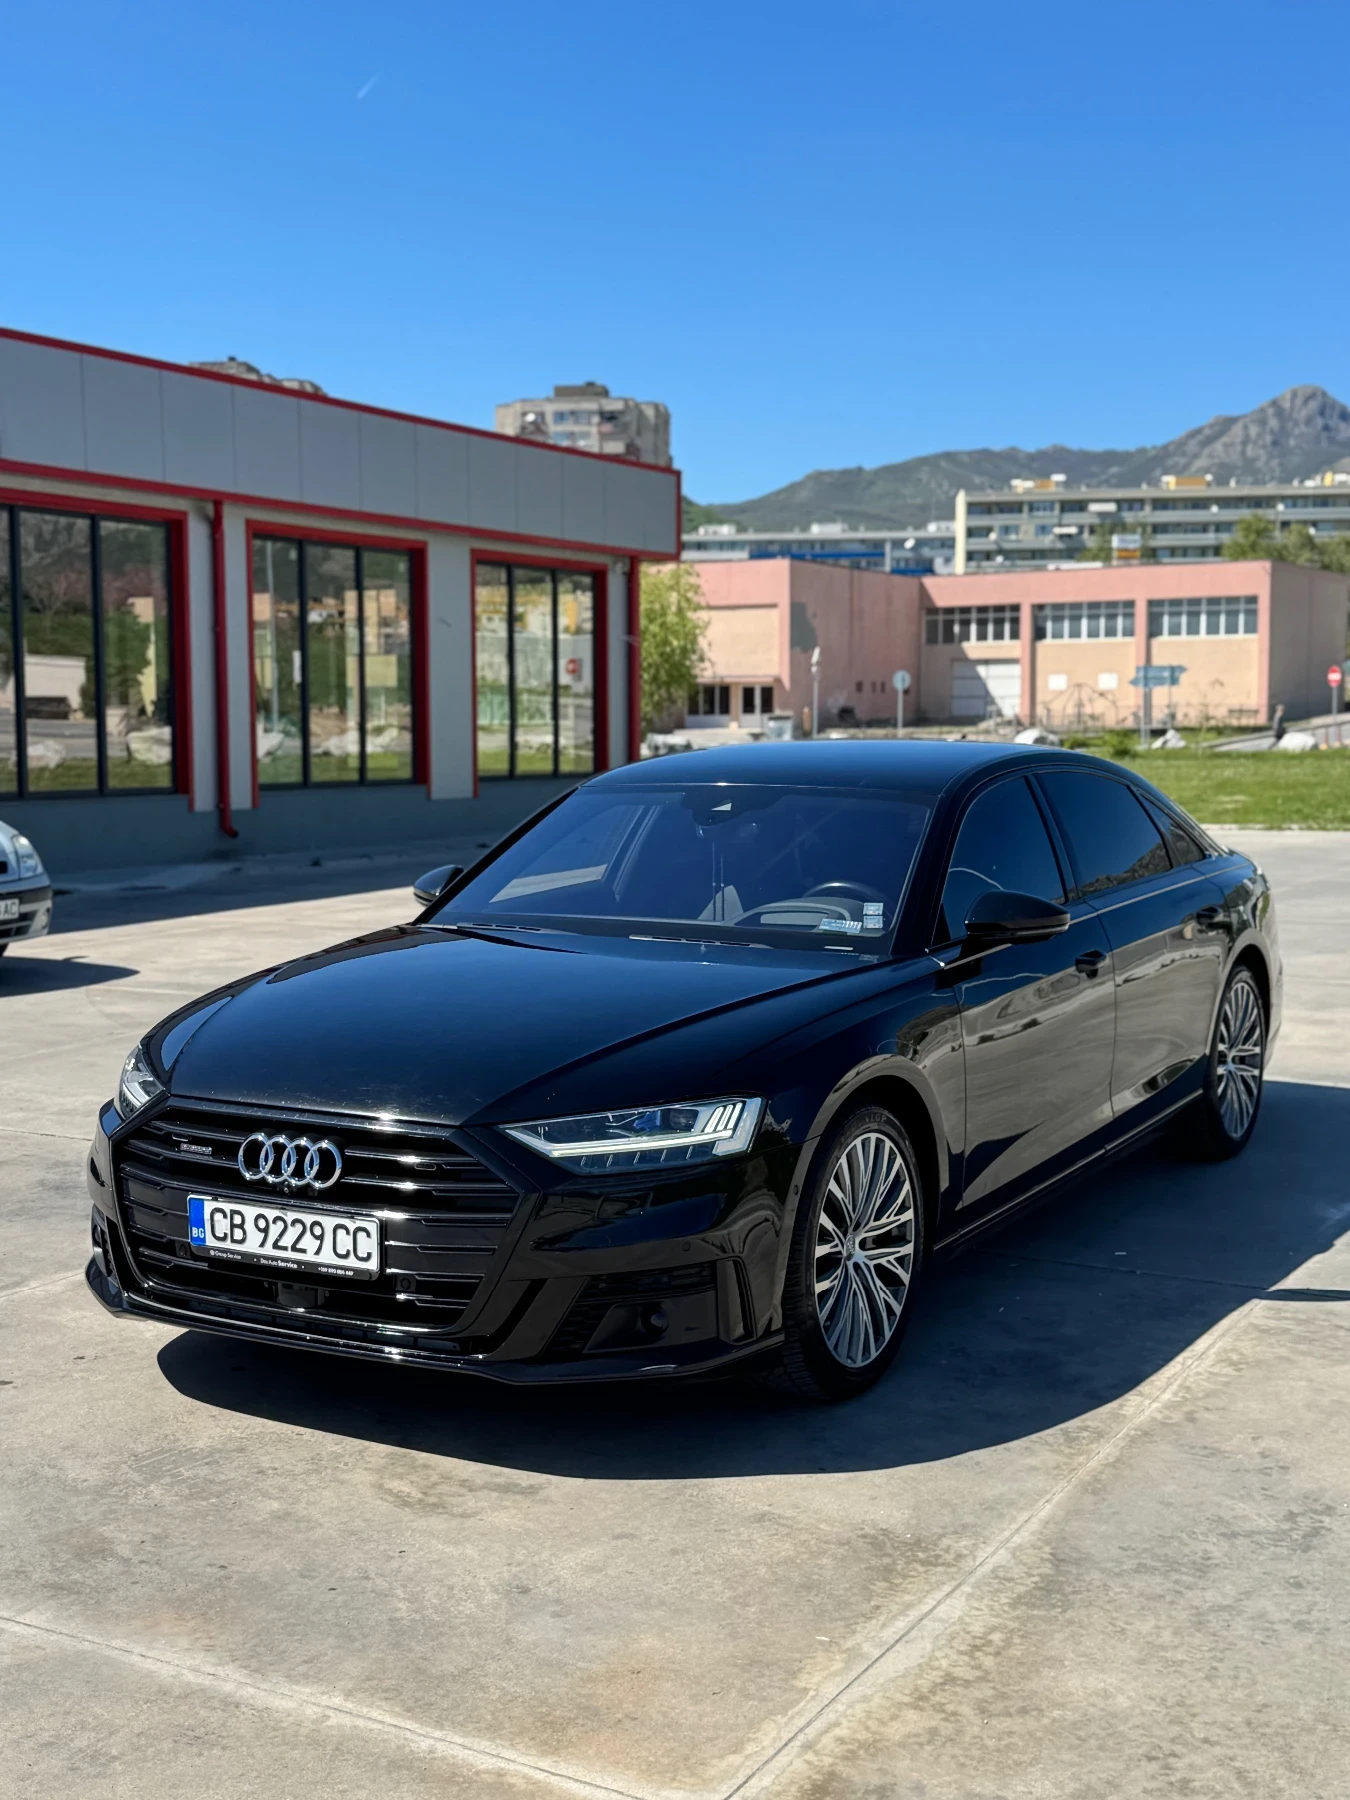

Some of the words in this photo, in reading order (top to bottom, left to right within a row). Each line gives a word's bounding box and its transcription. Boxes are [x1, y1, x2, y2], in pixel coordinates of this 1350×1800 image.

[192, 1227, 205, 1238] BG
[209, 1207, 247, 1244] CB
[253, 1213, 325, 1255] 9229
[333, 1223, 373, 1262] CC
[278, 1260, 298, 1269] Service
